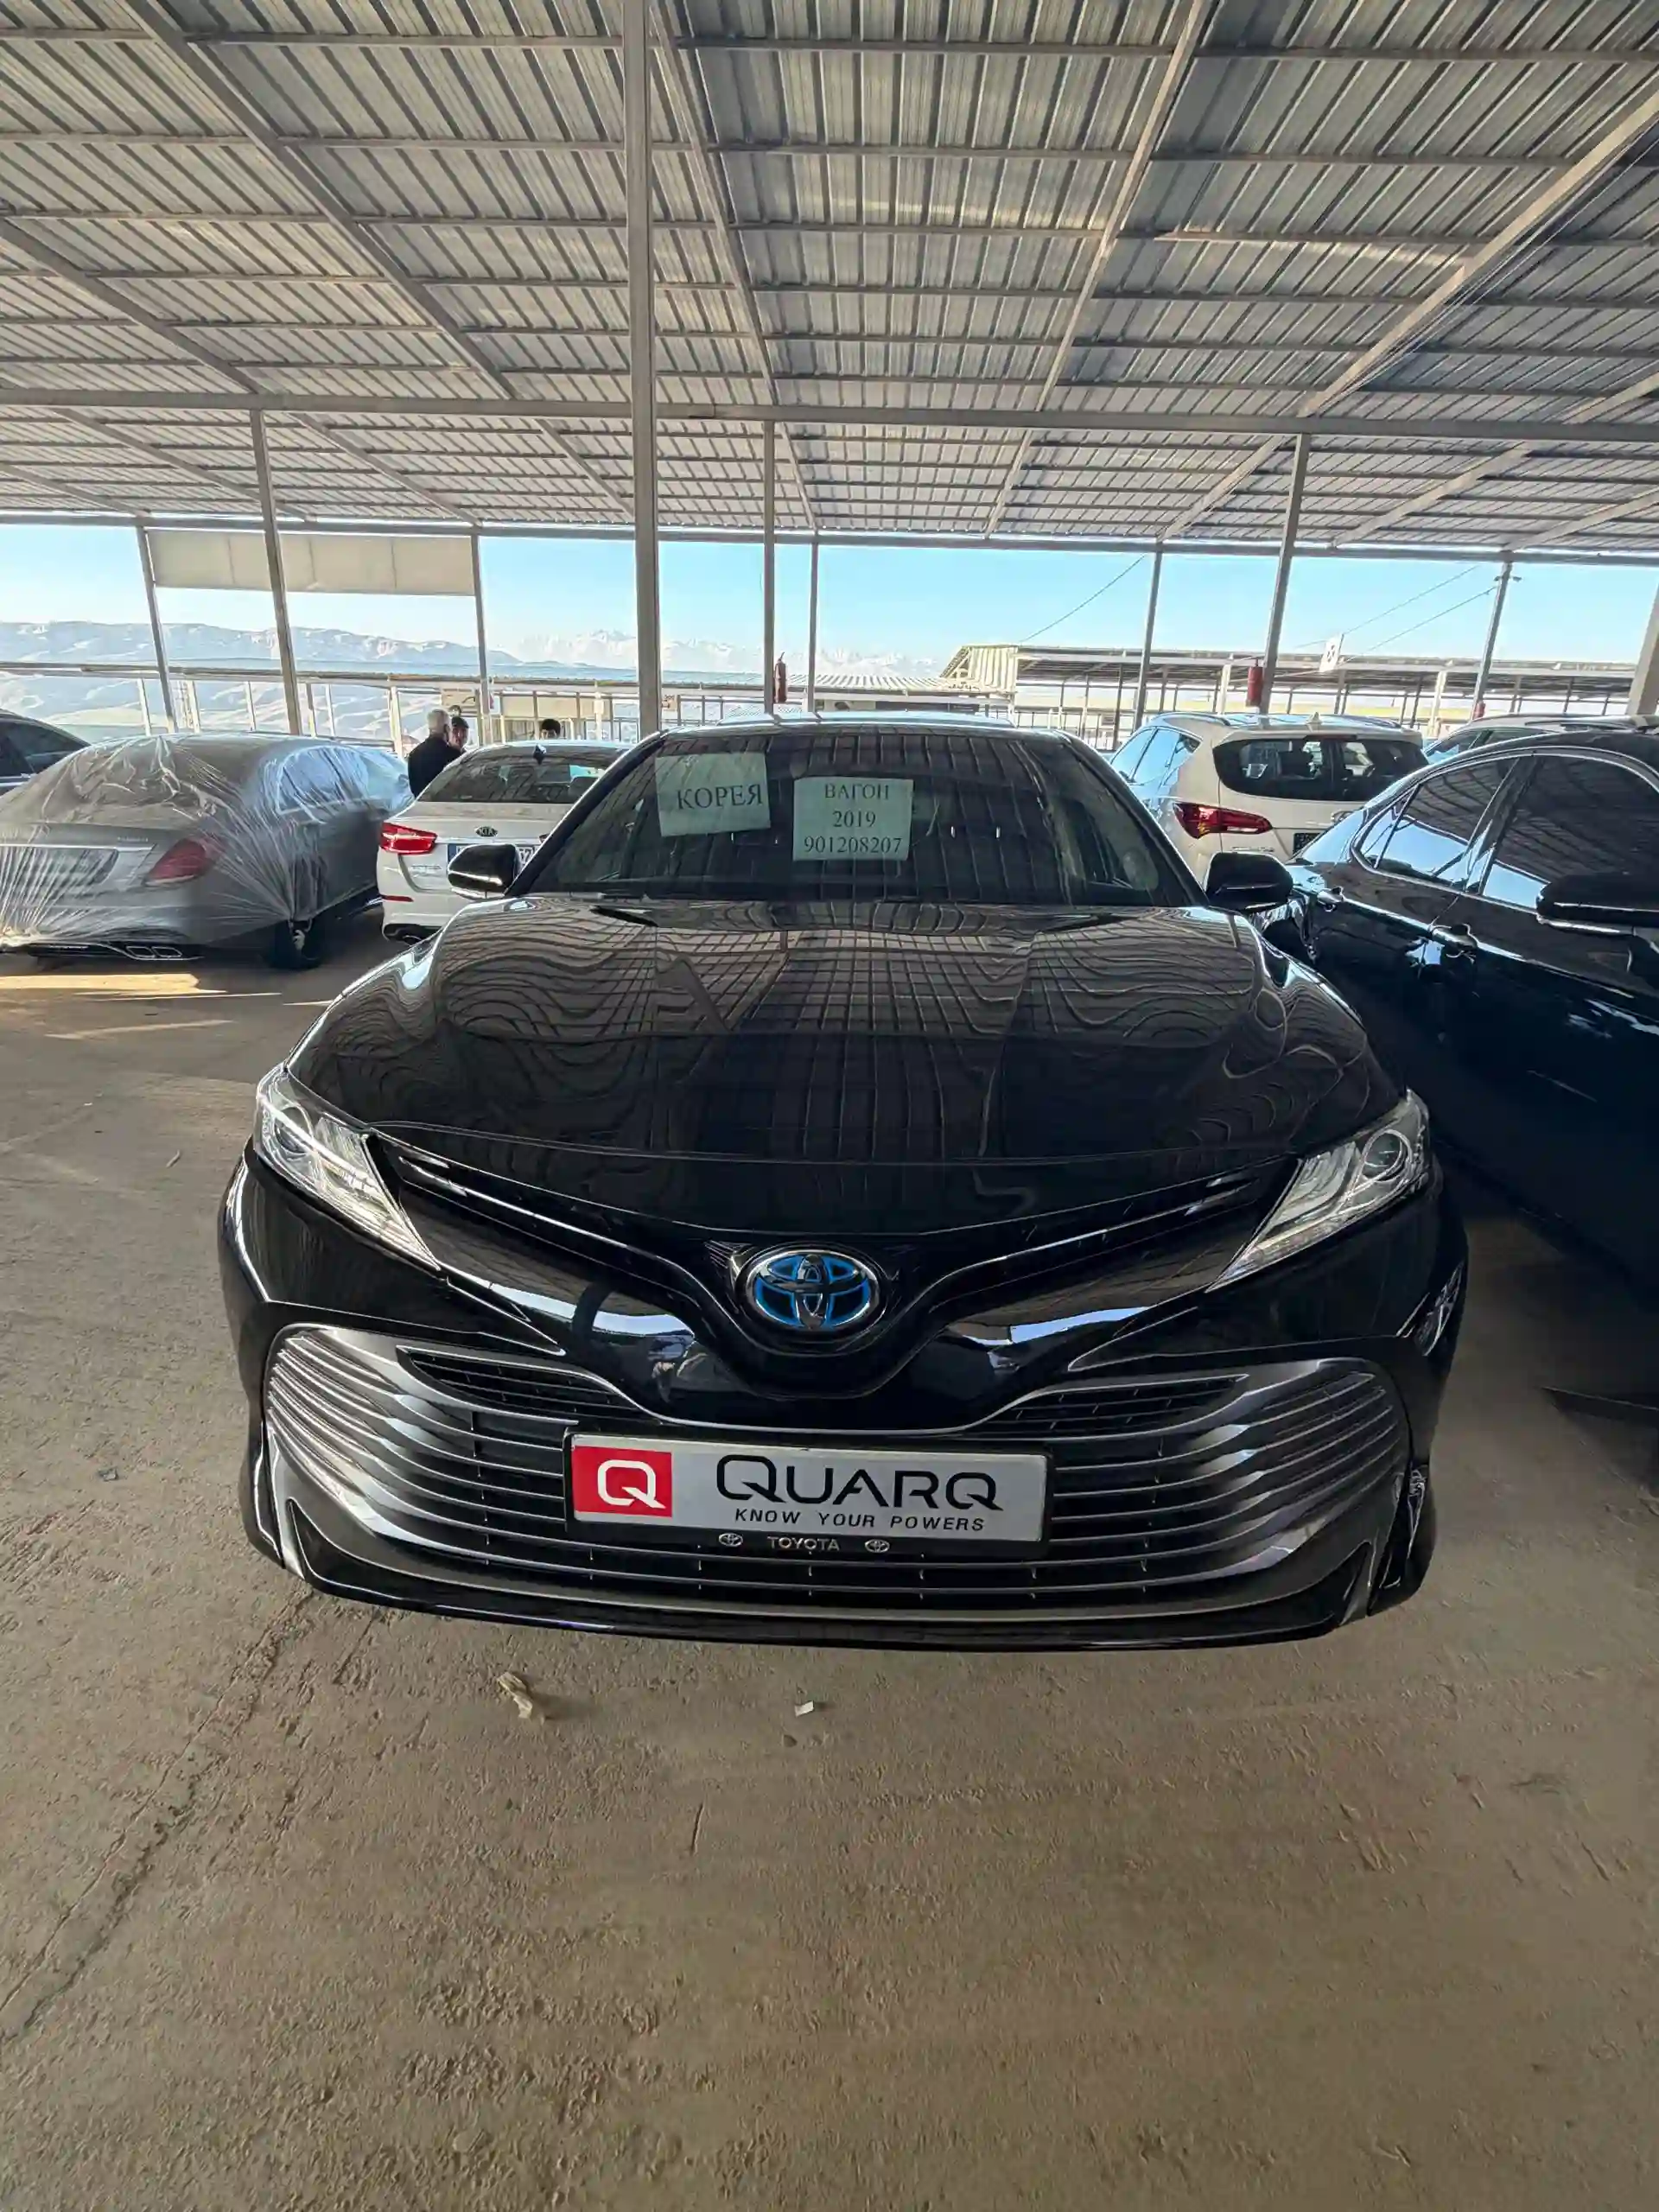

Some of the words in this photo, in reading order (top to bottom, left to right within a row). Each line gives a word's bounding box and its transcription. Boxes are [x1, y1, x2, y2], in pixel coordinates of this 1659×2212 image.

[677, 785, 763, 810] КОРЕЯ
[824, 784, 890, 800] ВАГОН
[832, 810, 877, 828] 2019
[804, 836, 902, 854] 901208207
[597, 1459, 666, 1509] Q
[716, 1454, 1003, 1510] QUARQ
[736, 1509, 800, 1524] KNOW
[818, 1512, 874, 1529] YOUR
[890, 1516, 985, 1531] POWERS
[766, 1535, 840, 1552] TOYOTA
